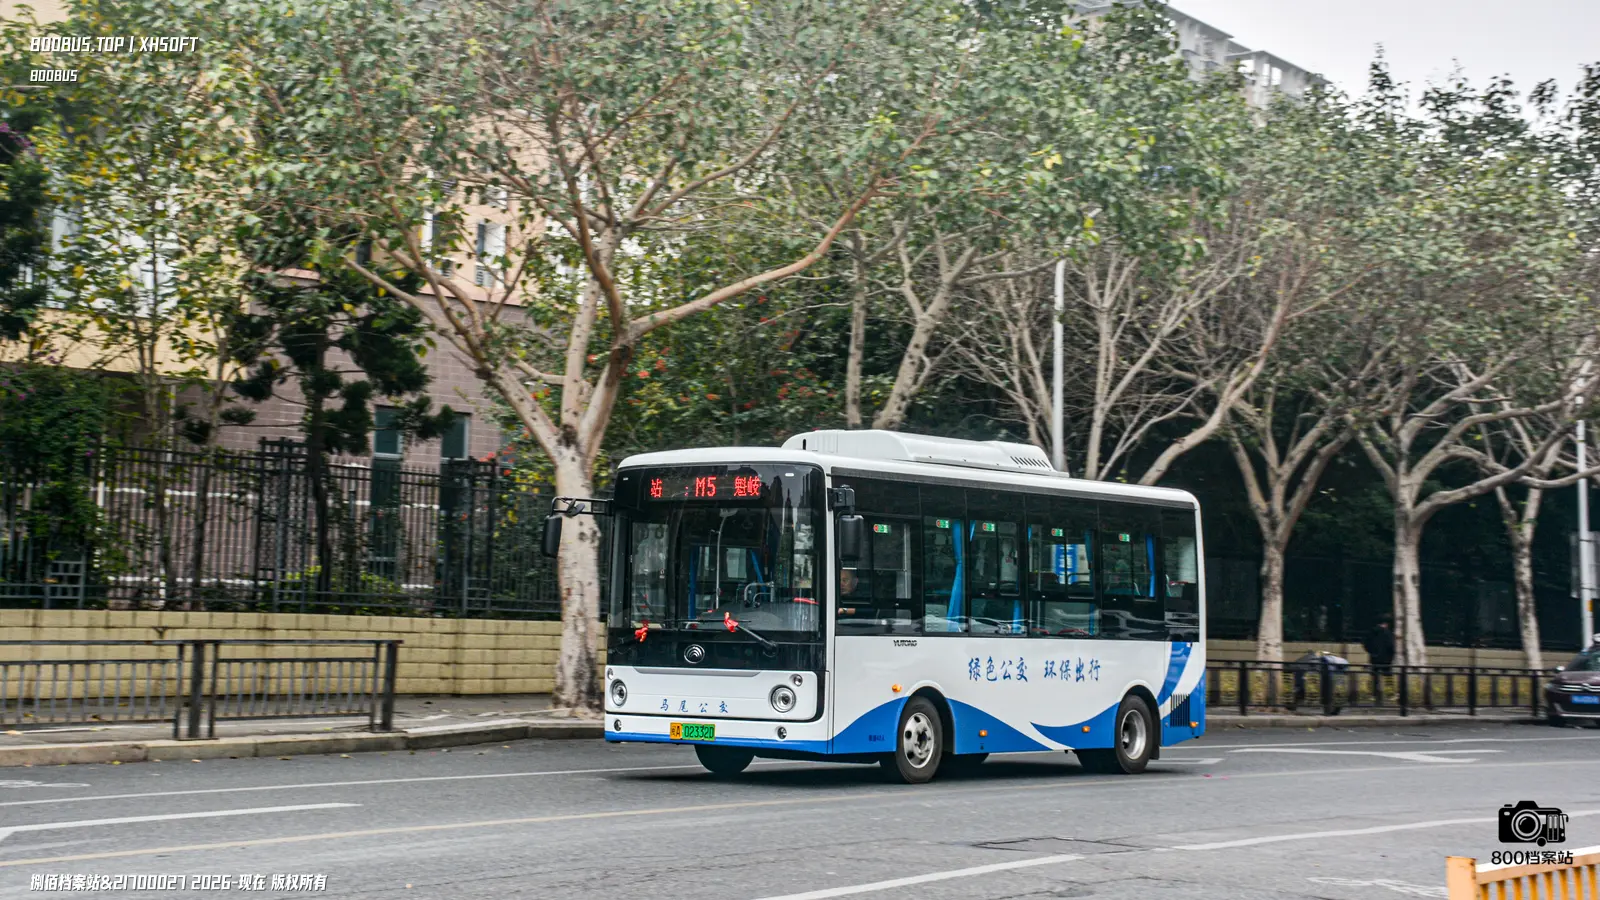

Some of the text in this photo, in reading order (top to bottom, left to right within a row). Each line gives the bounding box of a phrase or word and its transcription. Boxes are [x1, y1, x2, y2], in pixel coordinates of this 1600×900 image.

[650, 478, 663, 497] 站
[695, 476, 717, 497] M5
[733, 475, 762, 497] 魁岐
[968, 656, 1101, 682] 绿色公交 环保出行
